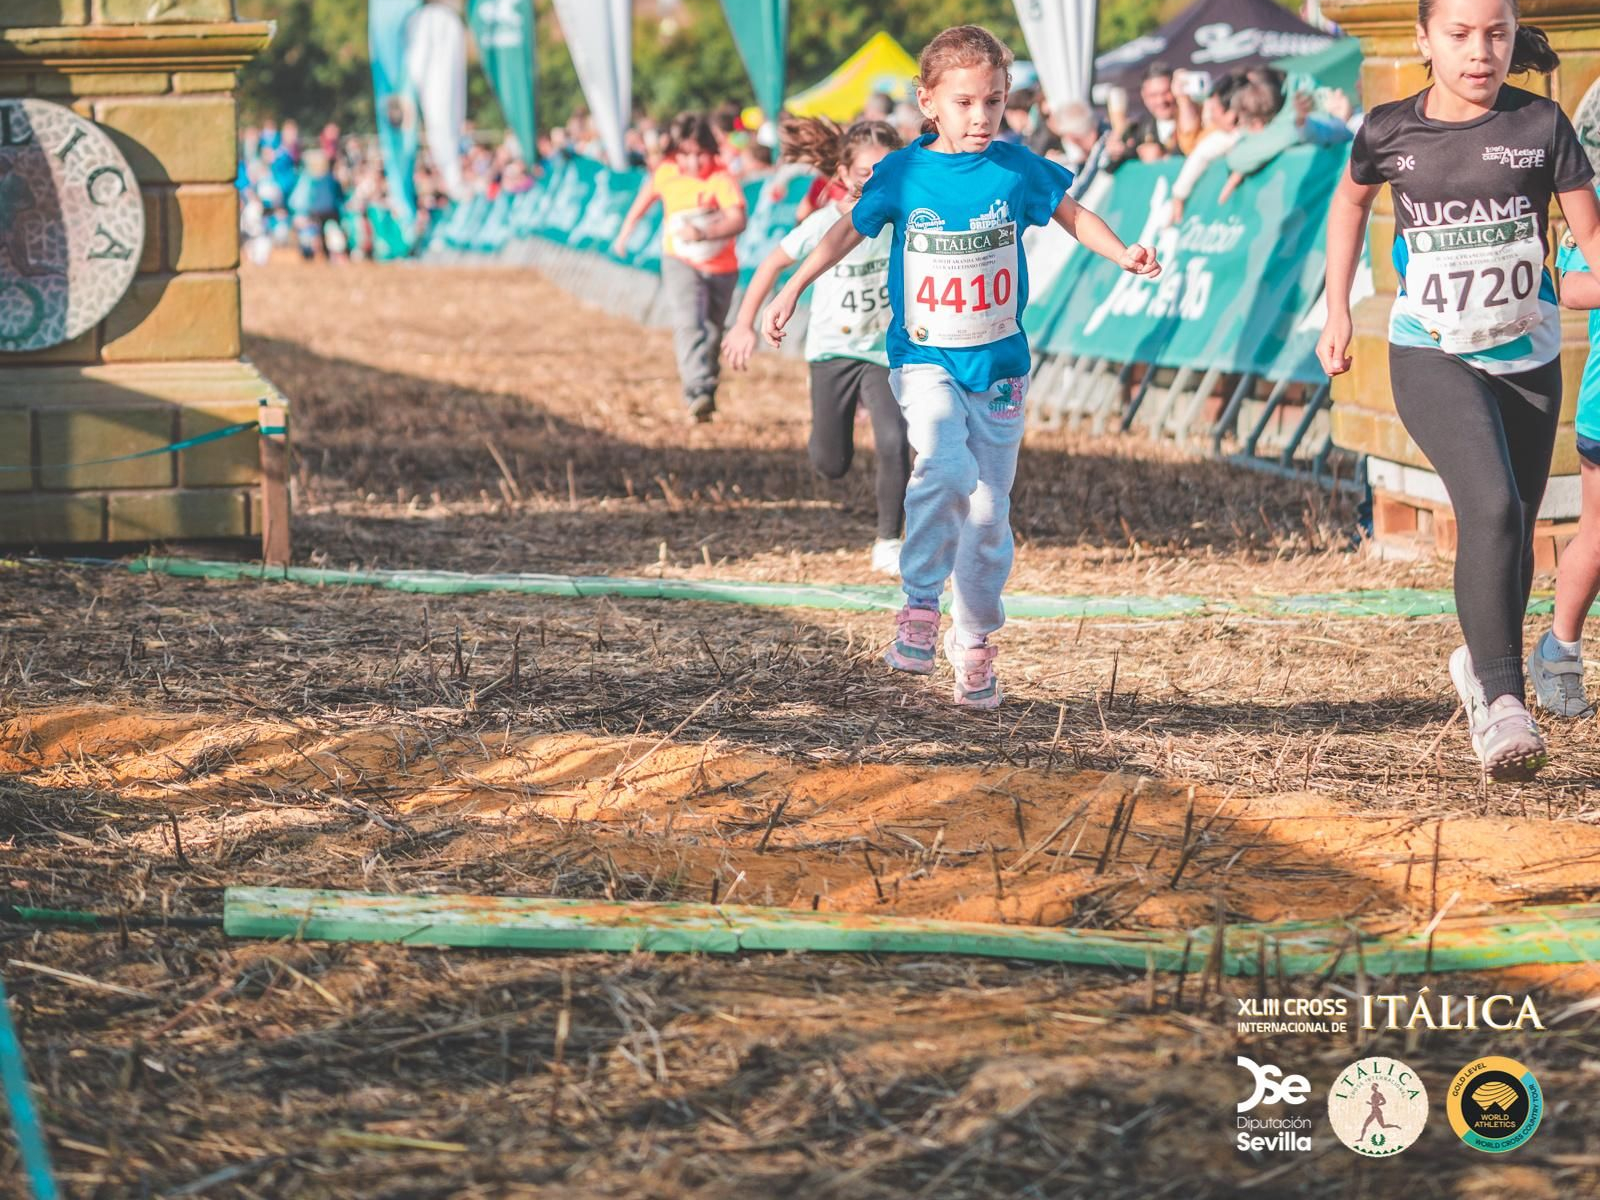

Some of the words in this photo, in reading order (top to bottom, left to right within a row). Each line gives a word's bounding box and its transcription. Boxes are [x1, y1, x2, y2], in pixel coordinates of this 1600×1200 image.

[935, 236, 992, 251] ITÁLICA
[1439, 228, 1506, 246] ITÁLICA
[916, 268, 1011, 313] 4410
[1421, 260, 1534, 313] 4720
